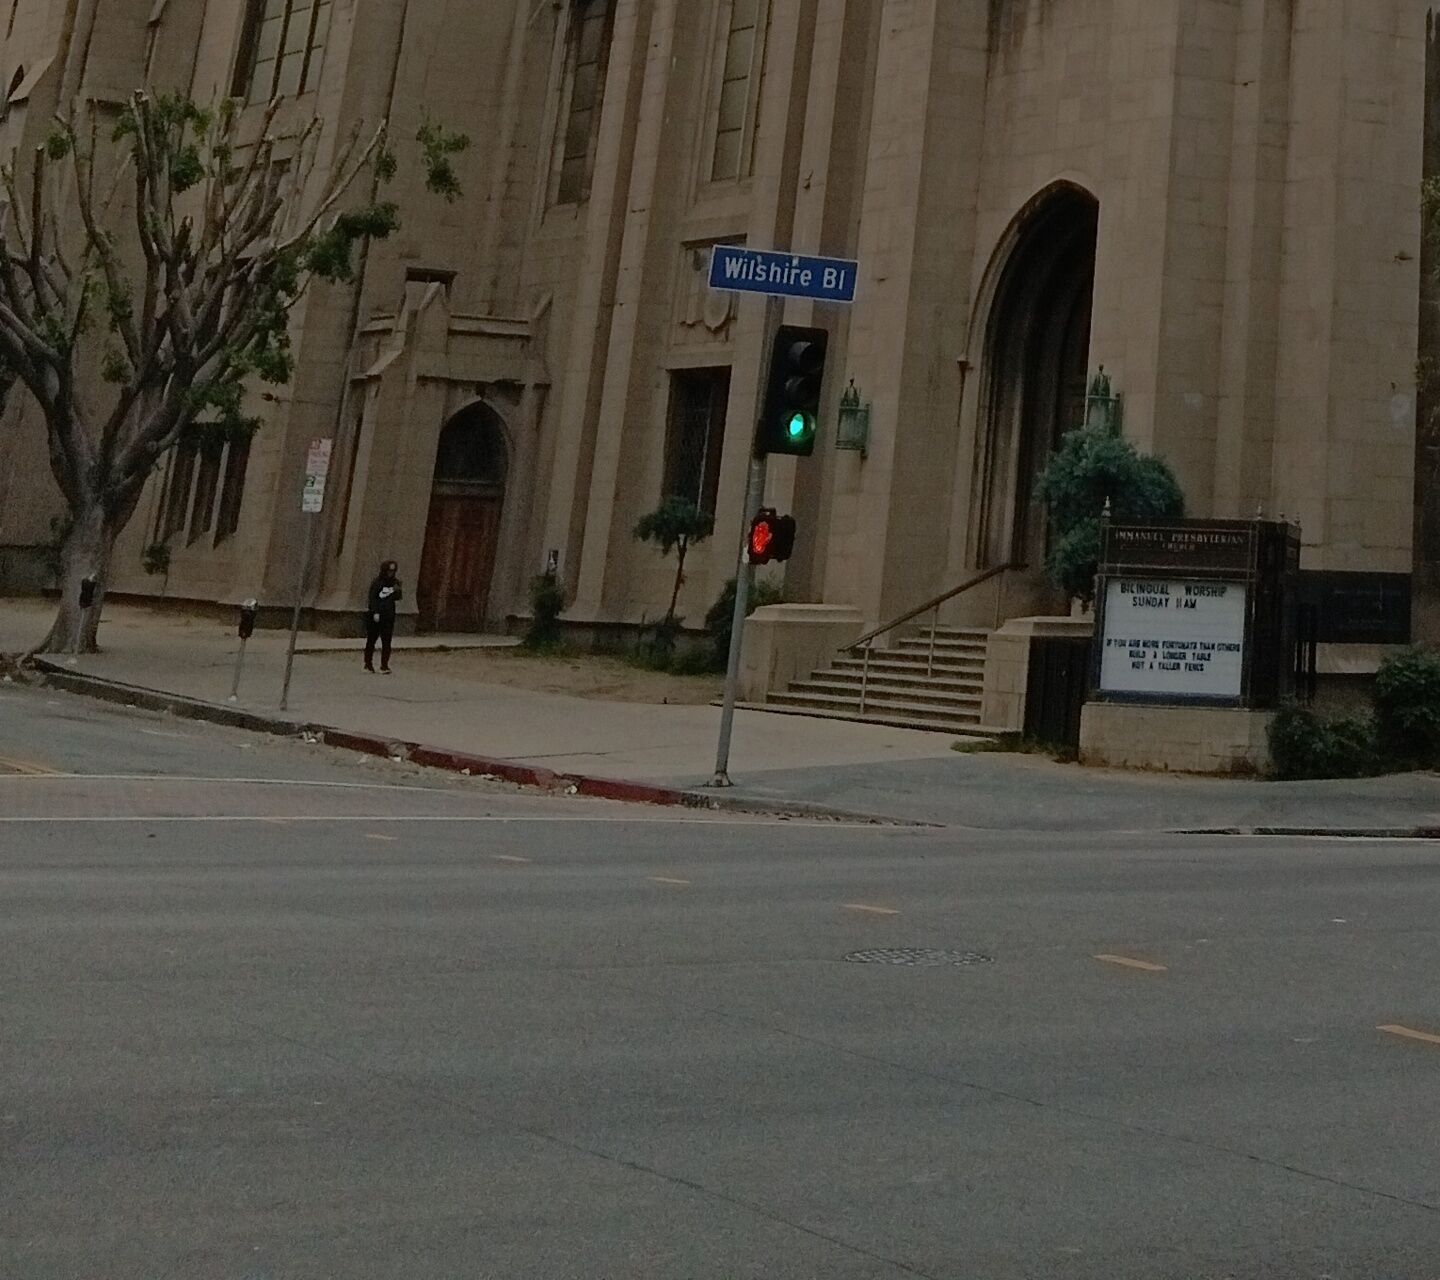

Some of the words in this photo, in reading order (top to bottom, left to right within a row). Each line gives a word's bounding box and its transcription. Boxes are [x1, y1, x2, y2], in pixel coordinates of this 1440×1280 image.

[725, 256, 812, 286] Wilshire
[823, 267, 845, 290] Bl
[1120, 583, 1170, 595] BILINGUAL
[1184, 585, 1227, 597] WORSHIP
[1132, 596, 1170, 608] SUNDAY
